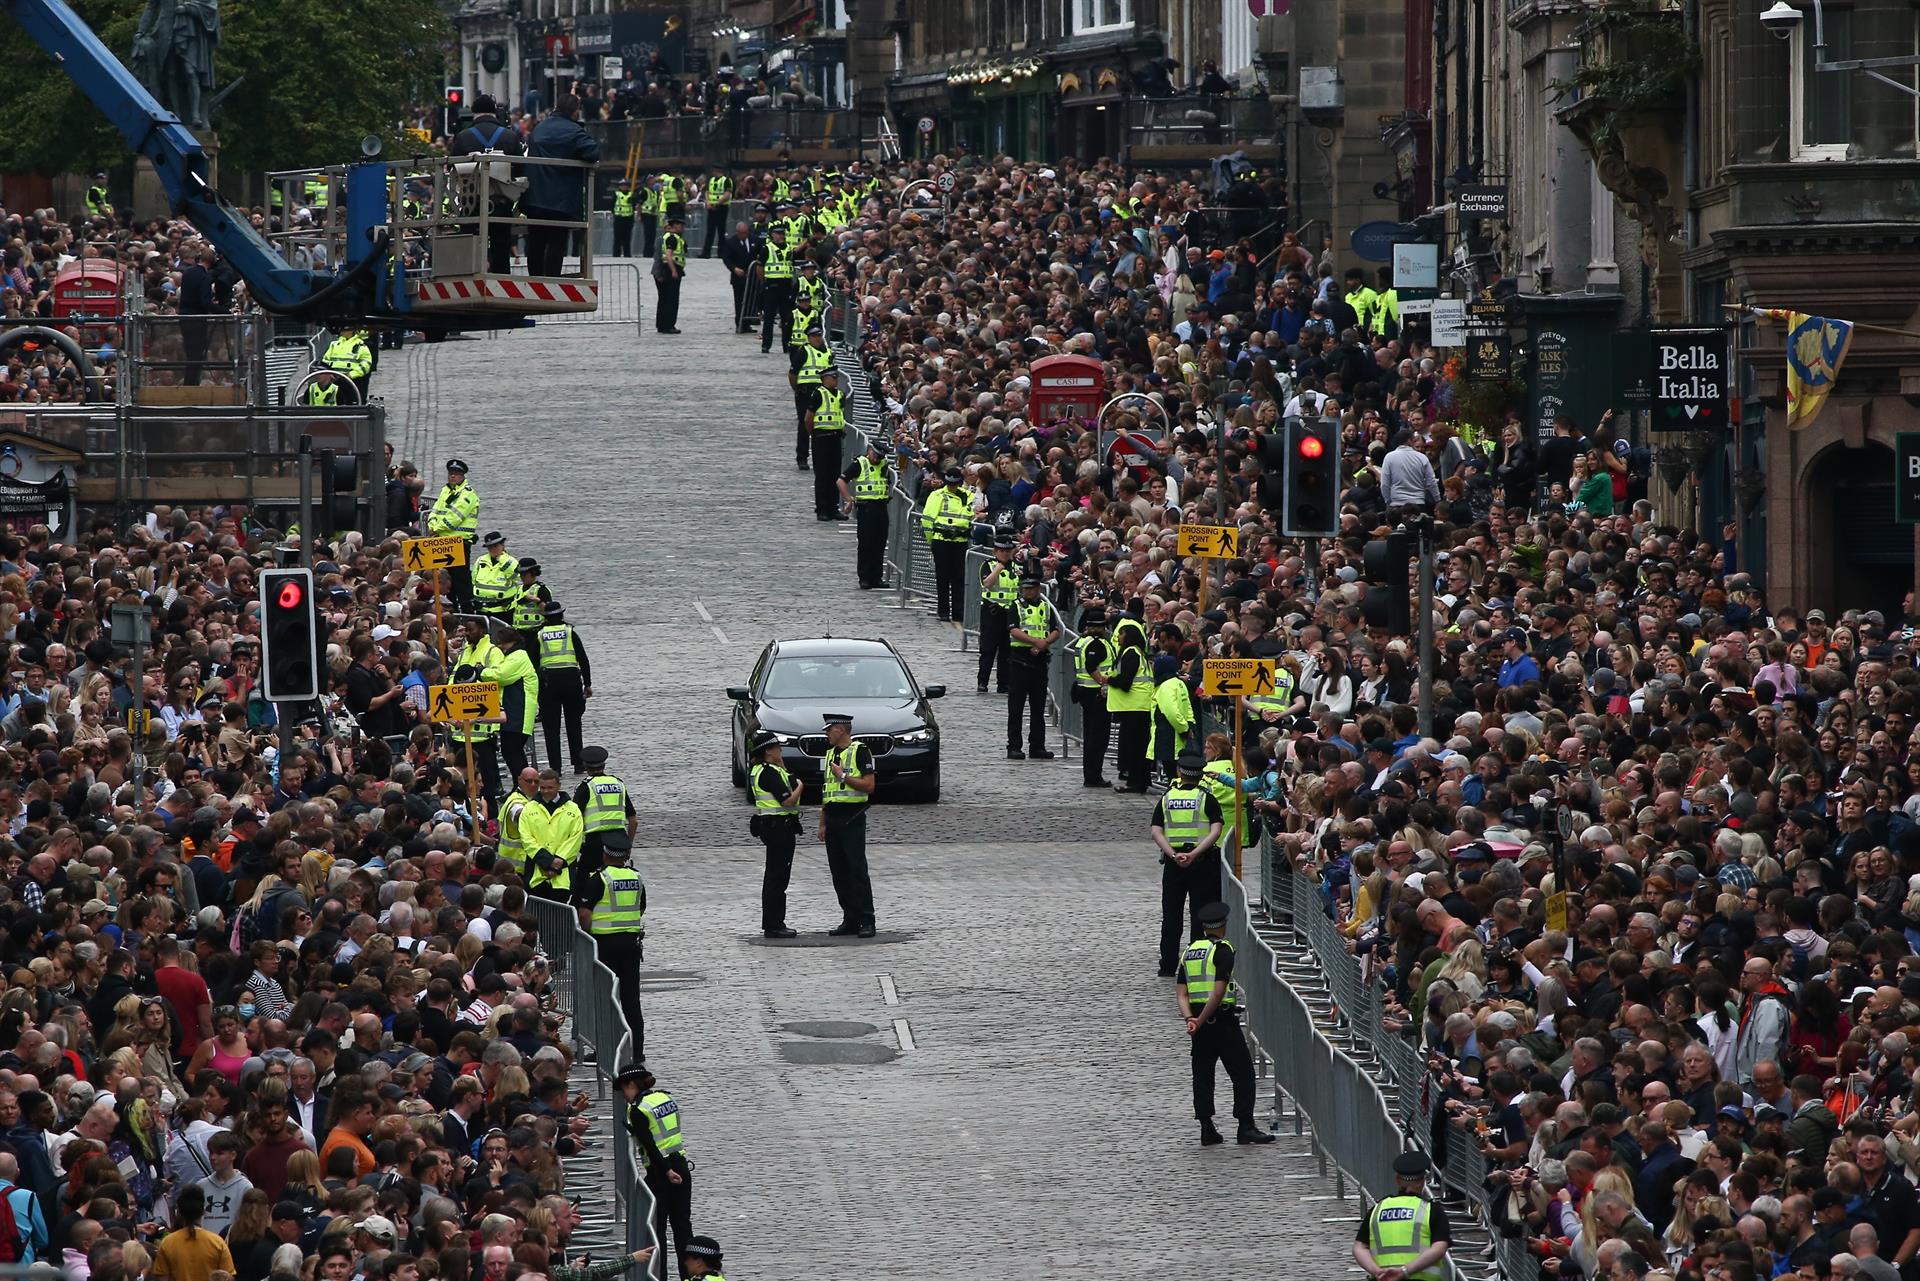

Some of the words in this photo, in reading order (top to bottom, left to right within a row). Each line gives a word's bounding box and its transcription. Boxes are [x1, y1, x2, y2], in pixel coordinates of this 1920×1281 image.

[940, 177, 953, 186] 20
[1461, 193, 1504, 204] Currency
[1459, 202, 1505, 213] Exchange
[1539, 352, 1562, 361] CASK
[1658, 345, 1719, 371] Bella
[1658, 375, 1720, 400] Italia
[1543, 408, 1554, 417] 300
[45, 502, 64, 511] TOURS
[1181, 526, 1219, 536] CROSSING
[423, 536, 462, 548] CROSSING
[1188, 535, 1209, 543] POINT
[432, 546, 454, 554] POINT
[543, 631, 566, 640] POLICE
[1206, 661, 1253, 670] CROSSING
[1216, 671, 1242, 679] POINT
[1276, 678, 1288, 687] ICE
[451, 683, 498, 695] CROSSING
[462, 694, 488, 703] POINT
[596, 784, 622, 793] POLICE
[1168, 800, 1195, 809] POLICE
[614, 880, 640, 890] POLICE
[1186, 950, 1207, 960] POLICE
[653, 1101, 678, 1118] POLICE
[1380, 1208, 1414, 1220] POLICE
